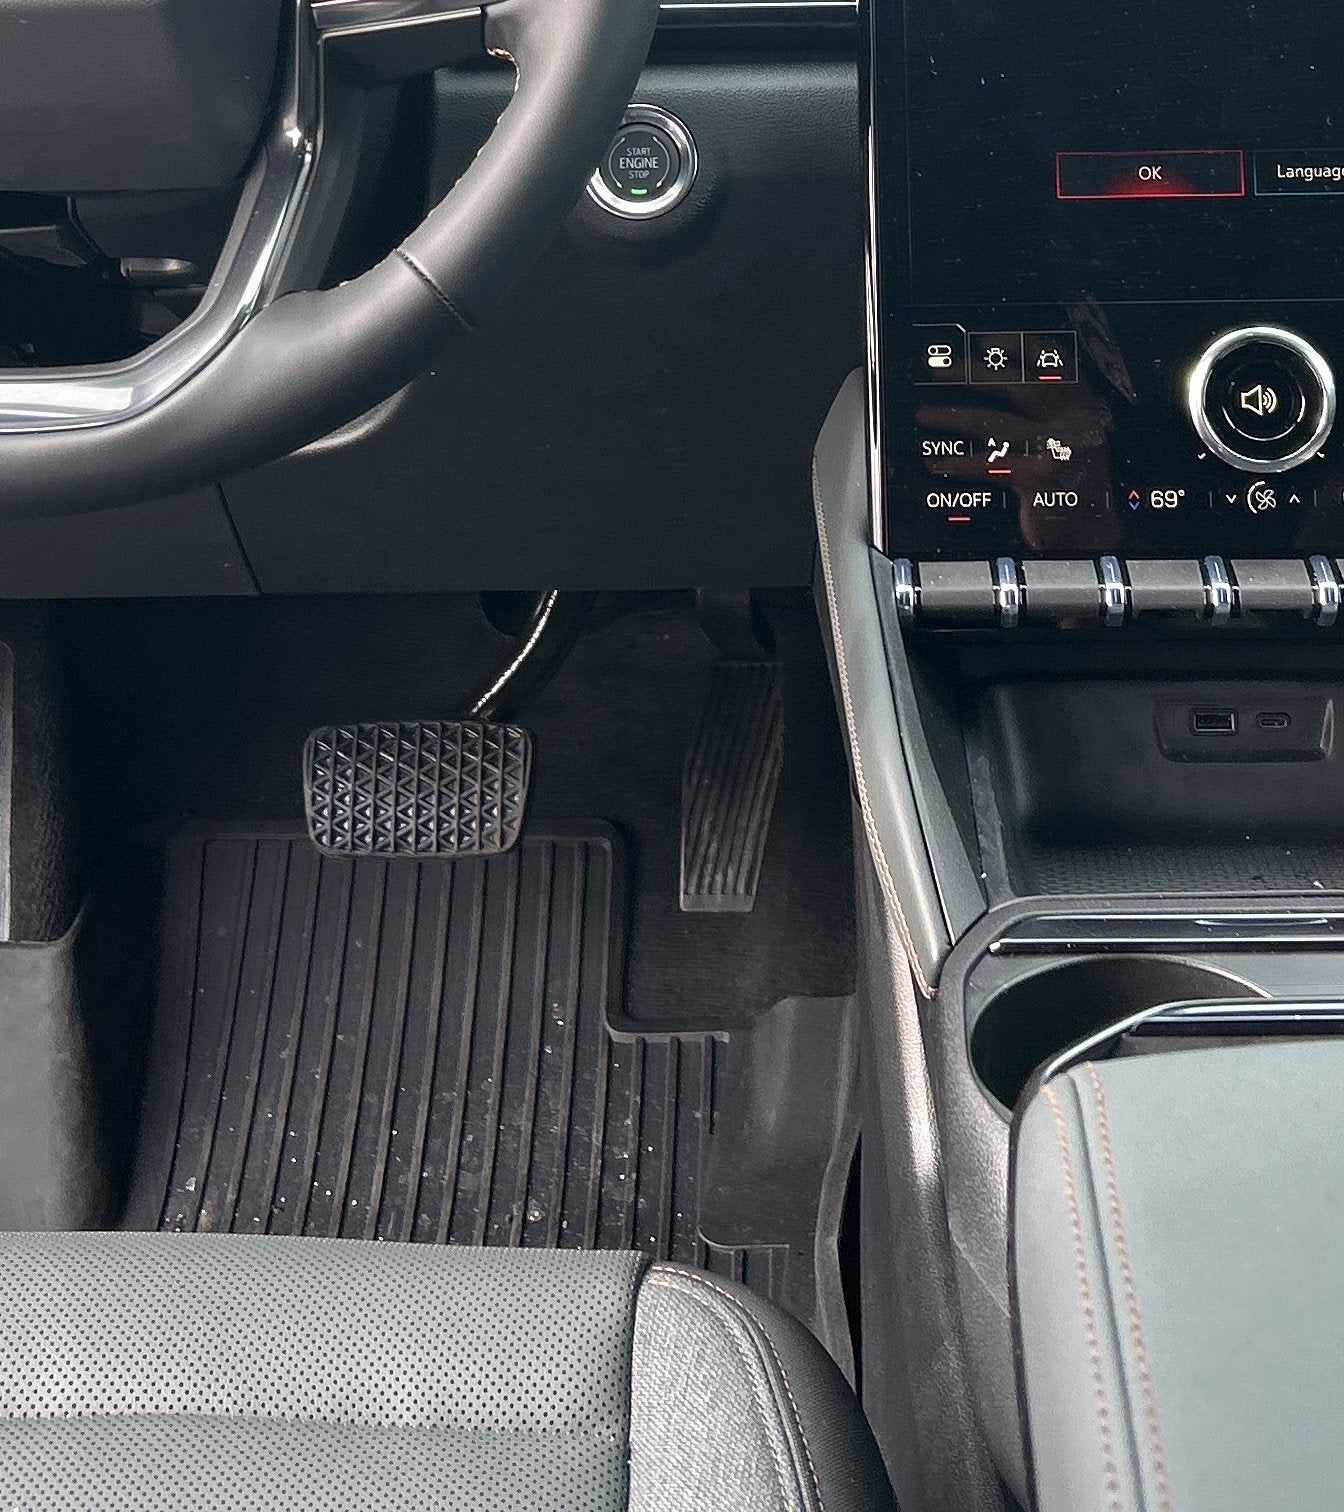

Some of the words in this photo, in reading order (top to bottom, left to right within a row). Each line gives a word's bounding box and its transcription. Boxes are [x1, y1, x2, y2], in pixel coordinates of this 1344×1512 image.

[626, 147, 652, 156] START
[619, 157, 659, 169] ENGINE
[628, 169, 650, 179] STOP
[1138, 166, 1162, 181] OK
[922, 440, 965, 456] SYNC
[926, 492, 993, 508] ON/OFF
[1033, 491, 1079, 507] AUTO
[1150, 488, 1186, 508] 69°
